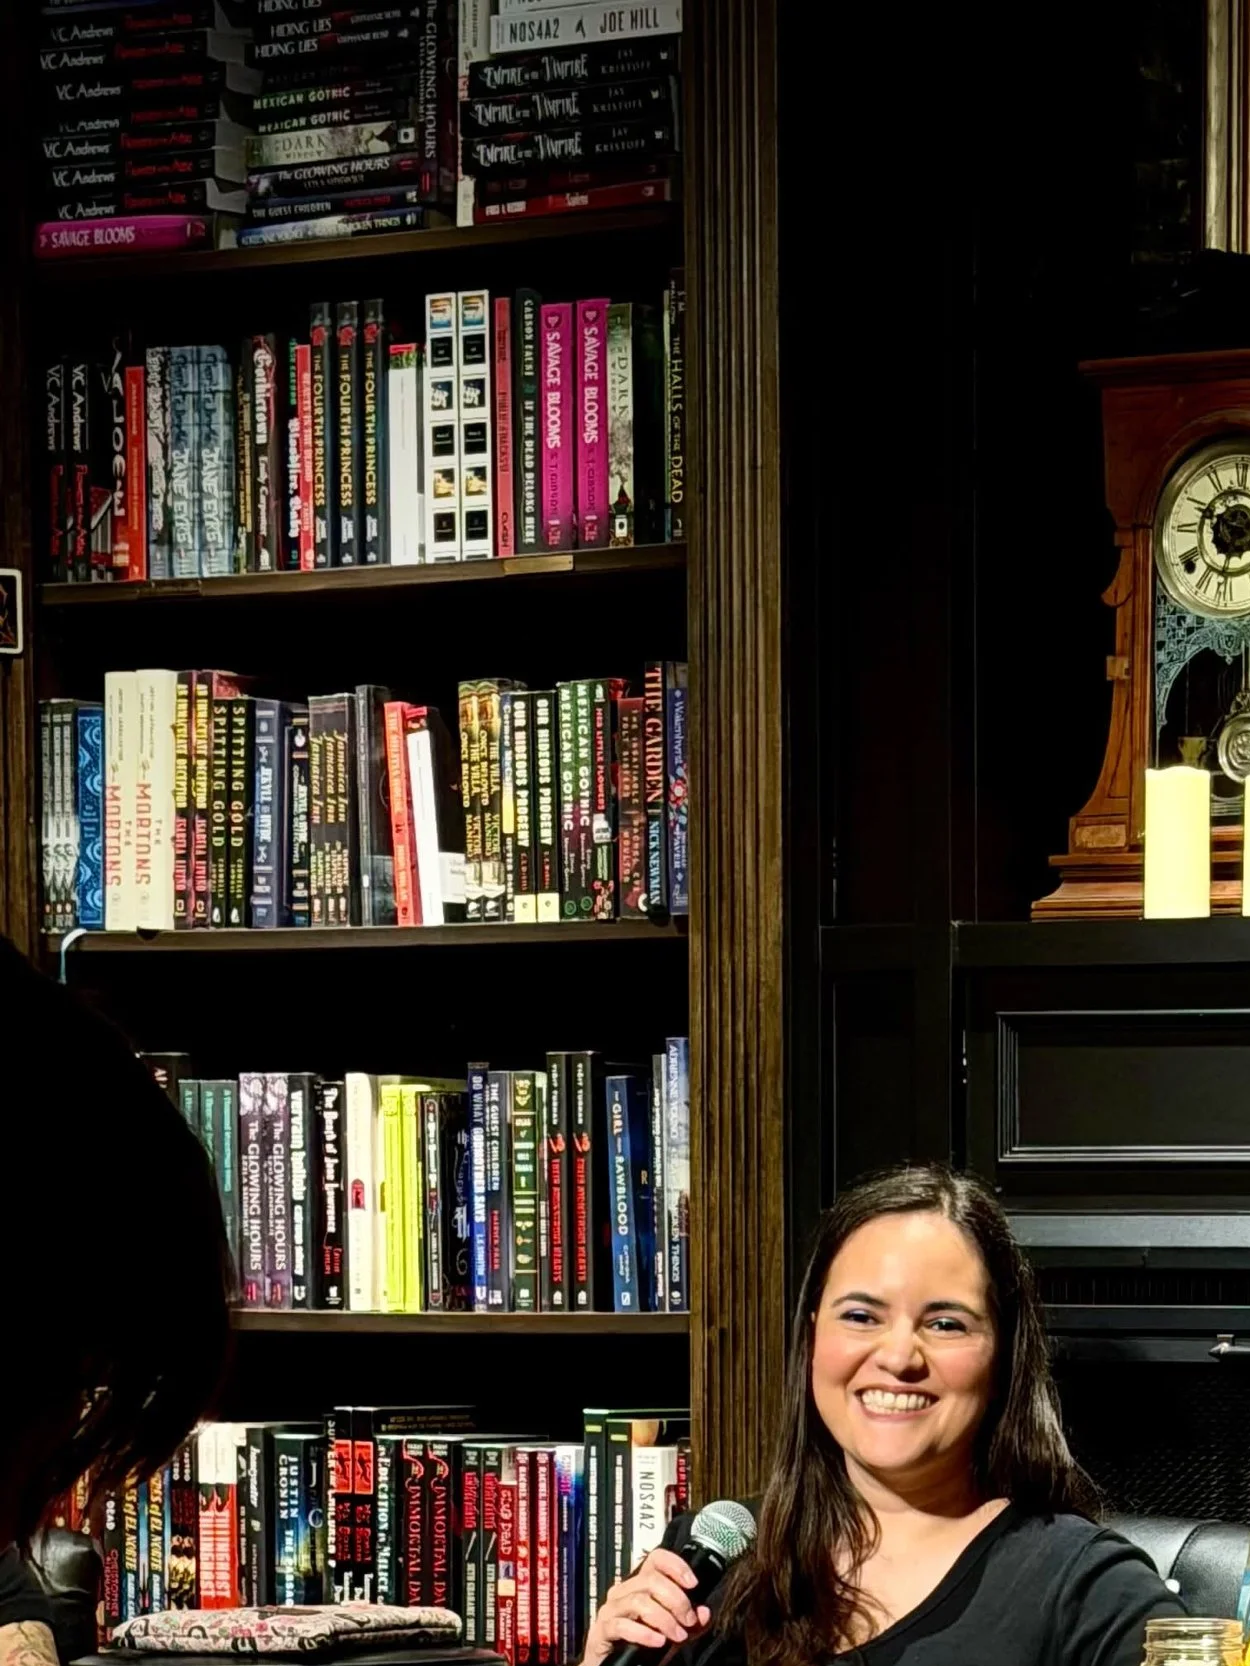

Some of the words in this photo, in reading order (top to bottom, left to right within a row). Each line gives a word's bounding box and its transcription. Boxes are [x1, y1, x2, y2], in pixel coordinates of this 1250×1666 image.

[510, 19, 559, 43] NOS4A2
[600, 11, 624, 34] JOE
[631, 8, 658, 30] HILL
[425, 23, 438, 101] GLOWING
[253, 94, 304, 110] MEXICAN
[308, 86, 352, 102] GOTHIC
[311, 109, 352, 124] GOTHIC
[425, 104, 438, 158] HOURS
[51, 230, 89, 247] SAVAGE
[94, 226, 135, 243] BLOOMS
[546, 331, 560, 387] SAVAGE
[585, 327, 599, 380] SAVAGE
[254, 348, 272, 444] Gothictown
[314, 374, 324, 437] FOURTH
[340, 378, 351, 440] FOURTH
[363, 372, 376, 436] FOURTH
[618, 357, 629, 418] DARK
[671, 360, 682, 410] HALLS
[524, 416, 534, 435] THE
[547, 392, 561, 448] BLOOMS
[584, 387, 599, 443] BLOOMS
[174, 449, 190, 495] JANE
[203, 448, 219, 493] JANE
[314, 439, 324, 506] PRINCESS
[340, 442, 352, 507] PRINCESS
[364, 438, 377, 506] PRINCESS
[524, 440, 534, 468] DEAD
[671, 456, 682, 503] DEAD
[524, 472, 534, 512] BELONG
[176, 501, 192, 544] EYRE
[205, 500, 220, 543] EYRE
[515, 701, 527, 726] OUR
[537, 699, 549, 724] OUR
[644, 668, 662, 711] THE
[561, 689, 573, 763] MEXICAN
[577, 684, 589, 758] MEXICAN
[310, 735, 323, 796] Jamaica
[324, 735, 336, 794] Jamaica
[336, 732, 347, 793] Jamaica
[515, 731, 527, 785] HIDEOUS
[537, 729, 550, 783] HIDEOUS
[645, 718, 662, 803] GARDEN
[313, 801, 323, 824] Inn
[326, 798, 336, 823] Inn
[338, 797, 348, 822] Inn
[517, 790, 529, 847] PROGENY
[539, 788, 552, 845] PROGENY
[563, 771, 574, 830] GOTHIC
[579, 766, 591, 825] GOTHIC
[261, 814, 272, 842] HYDE
[648, 821, 659, 850] NICK
[648, 852, 661, 904] NEWMAN
[249, 1121, 259, 1140] The
[274, 1121, 284, 1140] The
[248, 1144, 260, 1215] GLOWING
[273, 1144, 285, 1215] GLOWING
[250, 1219, 260, 1270] HOURS
[274, 1219, 285, 1270] HOURS
[280, 1454, 288, 1519] CRONIN
[290, 1456, 298, 1519] JUSTIN
[639, 1472, 654, 1530] NOS4A2
[285, 1530, 294, 1552] THE
